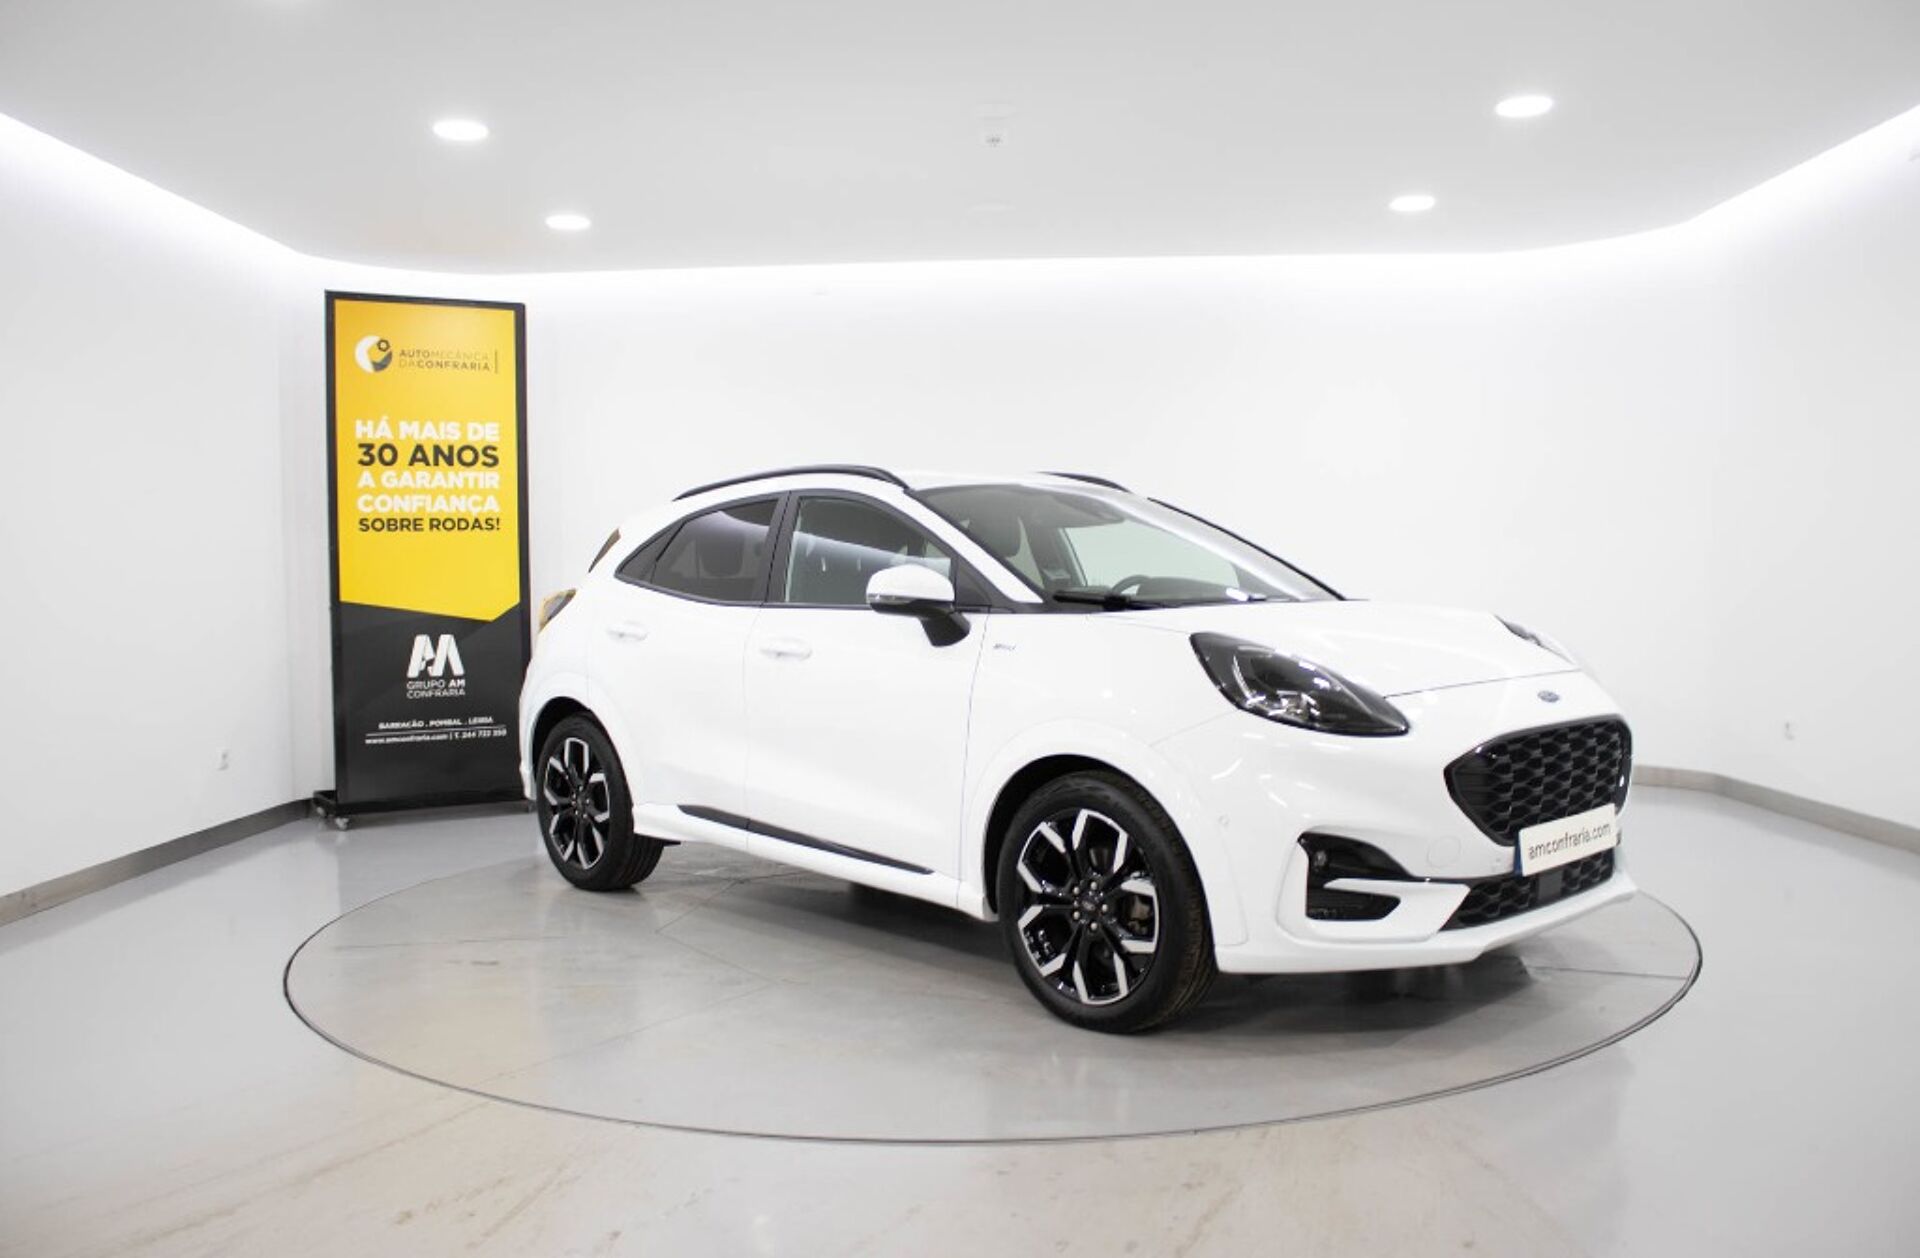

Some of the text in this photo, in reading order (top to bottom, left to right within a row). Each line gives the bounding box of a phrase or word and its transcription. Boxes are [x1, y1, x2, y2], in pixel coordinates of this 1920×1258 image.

[355, 415, 500, 442] HÁ MAIS DE
[357, 442, 500, 468] 30 ANOS
[357, 470, 500, 489] A GARANTIR
[356, 493, 500, 517] CONFIANÇA
[358, 517, 501, 533] SOBRE RODAS!
[406, 678, 466, 690] GRUPO AM
[406, 688, 466, 700] CONFRARIA
[1528, 823, 1611, 860] amconfraria.com
